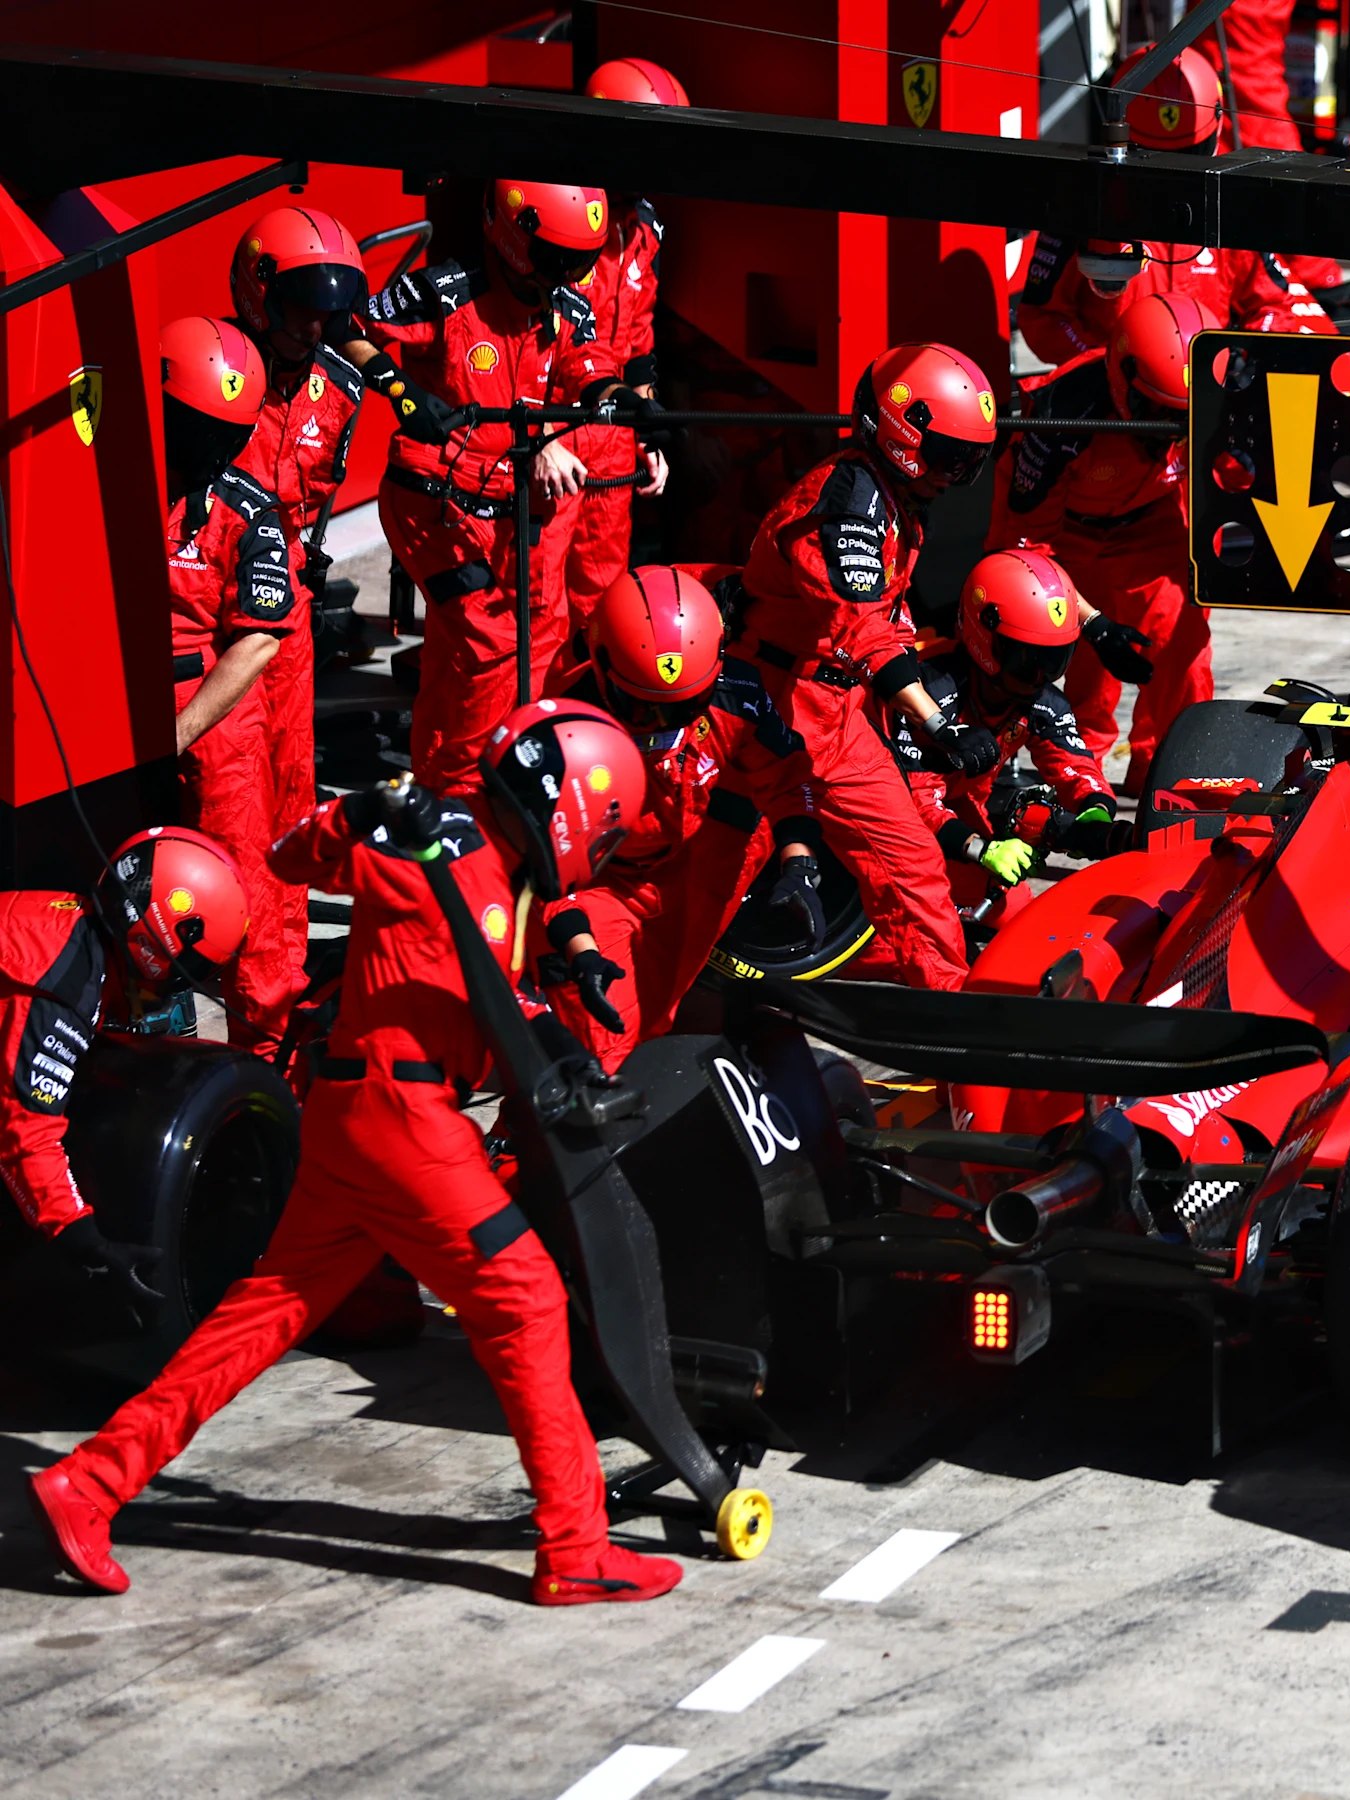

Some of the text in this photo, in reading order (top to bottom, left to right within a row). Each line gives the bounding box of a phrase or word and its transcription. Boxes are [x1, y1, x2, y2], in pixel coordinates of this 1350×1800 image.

[848, 538, 880, 556] Palantir
[843, 570, 880, 585] VGW
[251, 584, 285, 603] VGW
[852, 583, 872, 592] PLAY
[255, 597, 278, 608] PLAY
[552, 811, 572, 855] CEVA
[29, 1070, 69, 1100] VGW
[31, 1088, 56, 1104] PLAY
